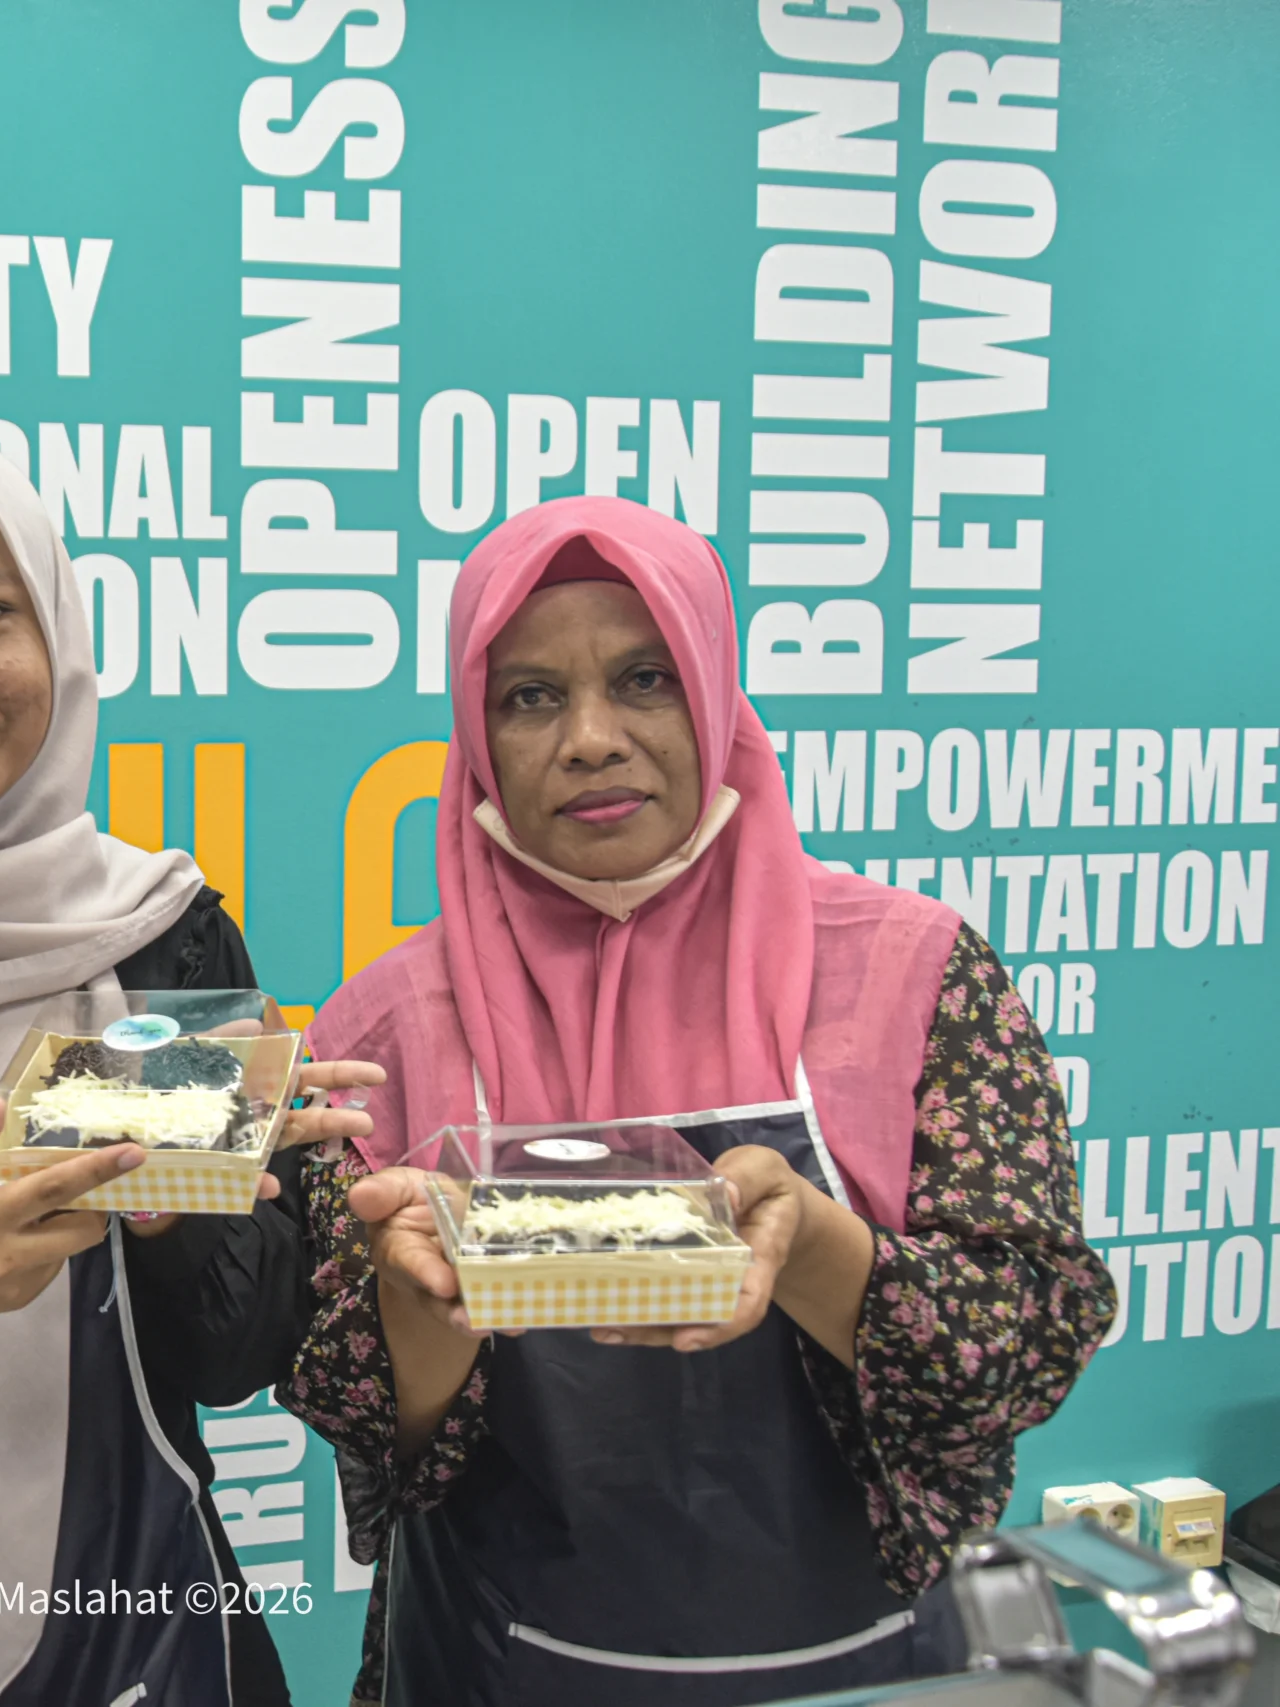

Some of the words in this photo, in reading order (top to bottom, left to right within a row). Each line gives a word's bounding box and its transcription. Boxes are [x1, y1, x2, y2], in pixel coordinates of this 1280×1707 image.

[238, 0, 406, 690] OPENESS
[746, 0, 904, 694] BUILDING
[419, 388, 720, 535] OPEN
[767, 728, 1279, 833] MPOWERME
[825, 850, 1269, 954] NTATION
[1006, 963, 1097, 1034] OR
[1074, 1127, 1280, 1239] LLEN
